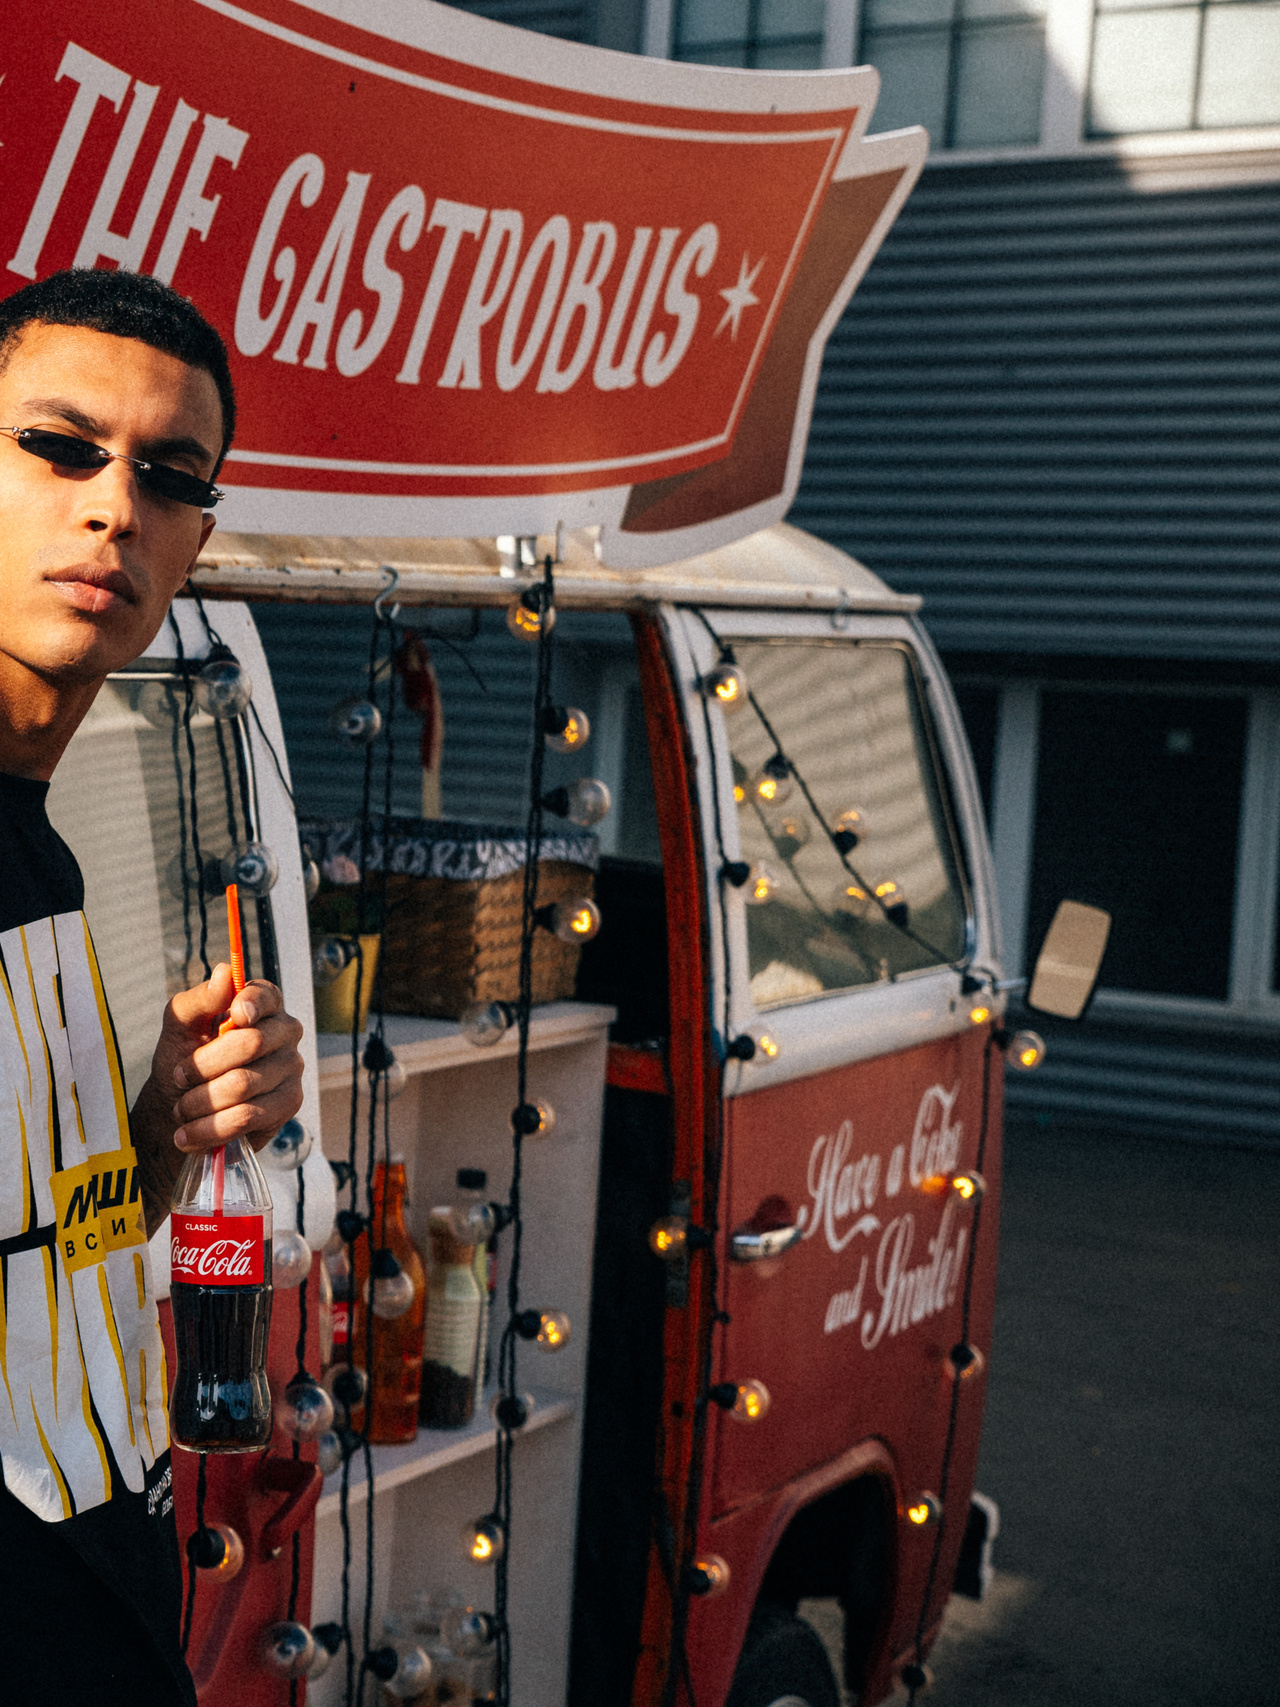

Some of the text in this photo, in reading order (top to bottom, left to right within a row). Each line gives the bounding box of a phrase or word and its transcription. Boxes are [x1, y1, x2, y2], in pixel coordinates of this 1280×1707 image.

[6, 40, 719, 393] THE GASTROBUS
[797, 1080, 963, 1253] Have a Coke
[171, 1236, 257, 1276] Coca-Cola
[185, 1223, 218, 1232] CLASSIC
[824, 1256, 868, 1334] and
